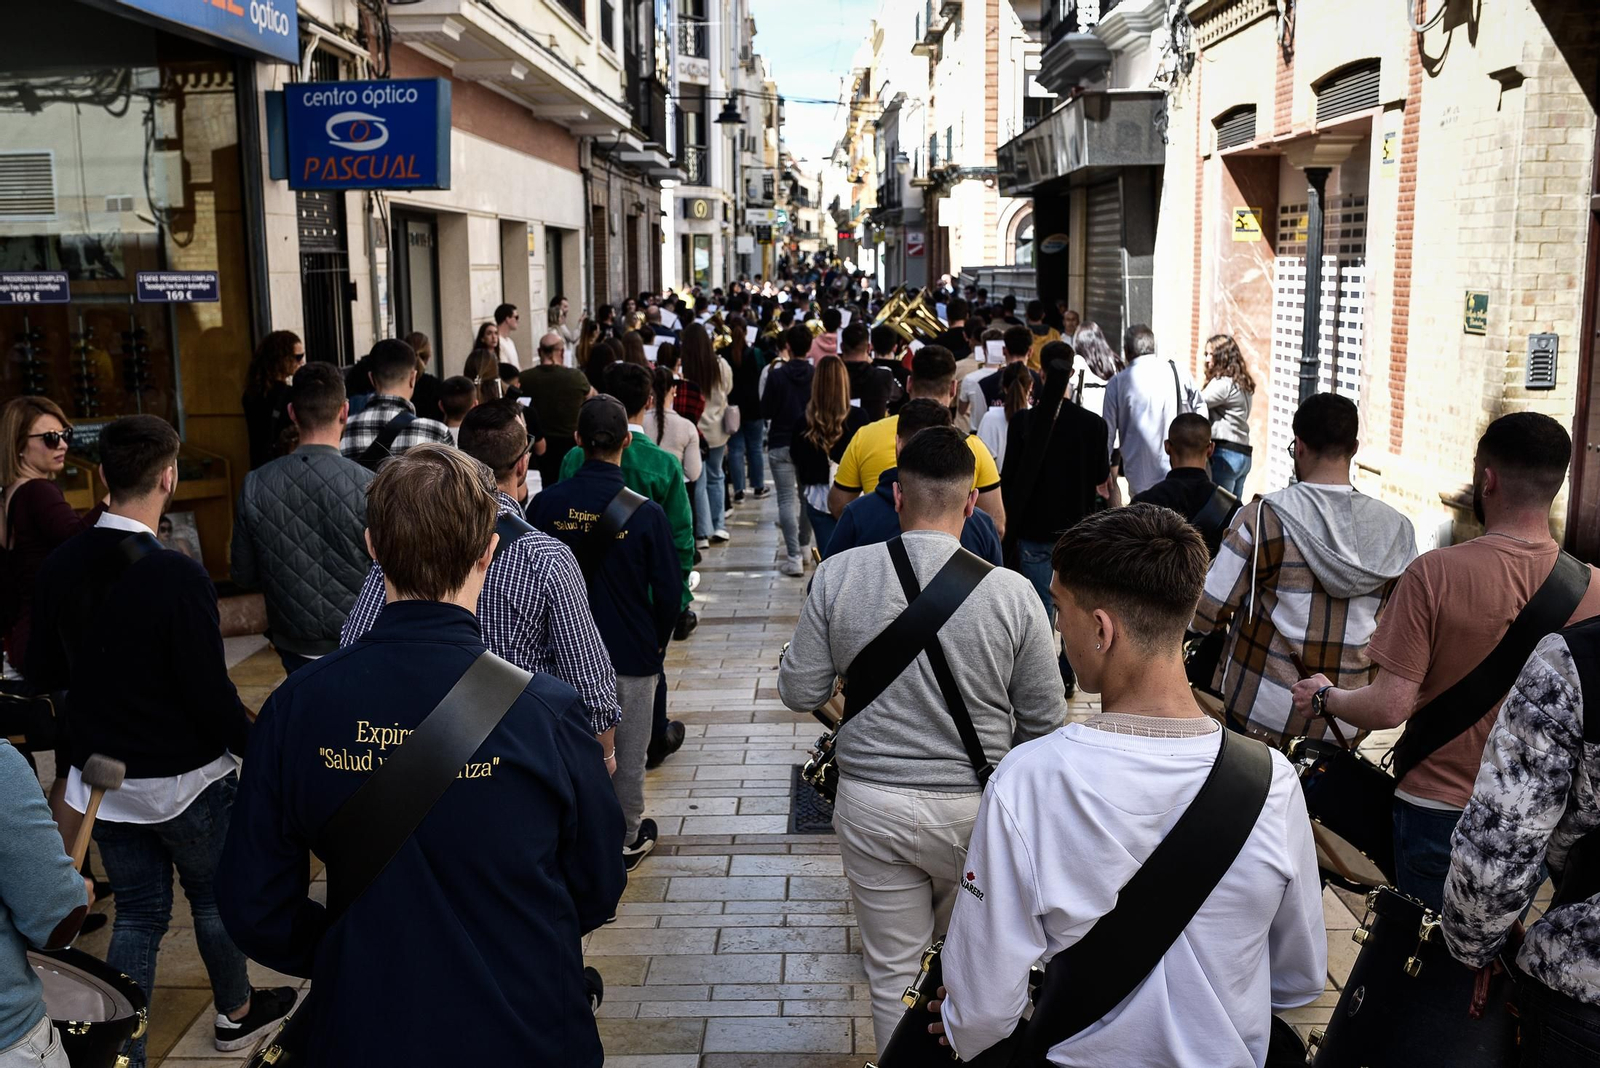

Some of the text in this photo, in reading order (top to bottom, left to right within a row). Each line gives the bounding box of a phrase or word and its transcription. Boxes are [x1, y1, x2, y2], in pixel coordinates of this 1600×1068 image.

[303, 85, 418, 109] centro óptico
[304, 155, 420, 181] PASCUAL
[10, 291, 40, 302] 169 €
[166, 290, 192, 300] 169 €
[356, 721, 414, 750] Expir
[320, 747, 373, 771] "Salud
